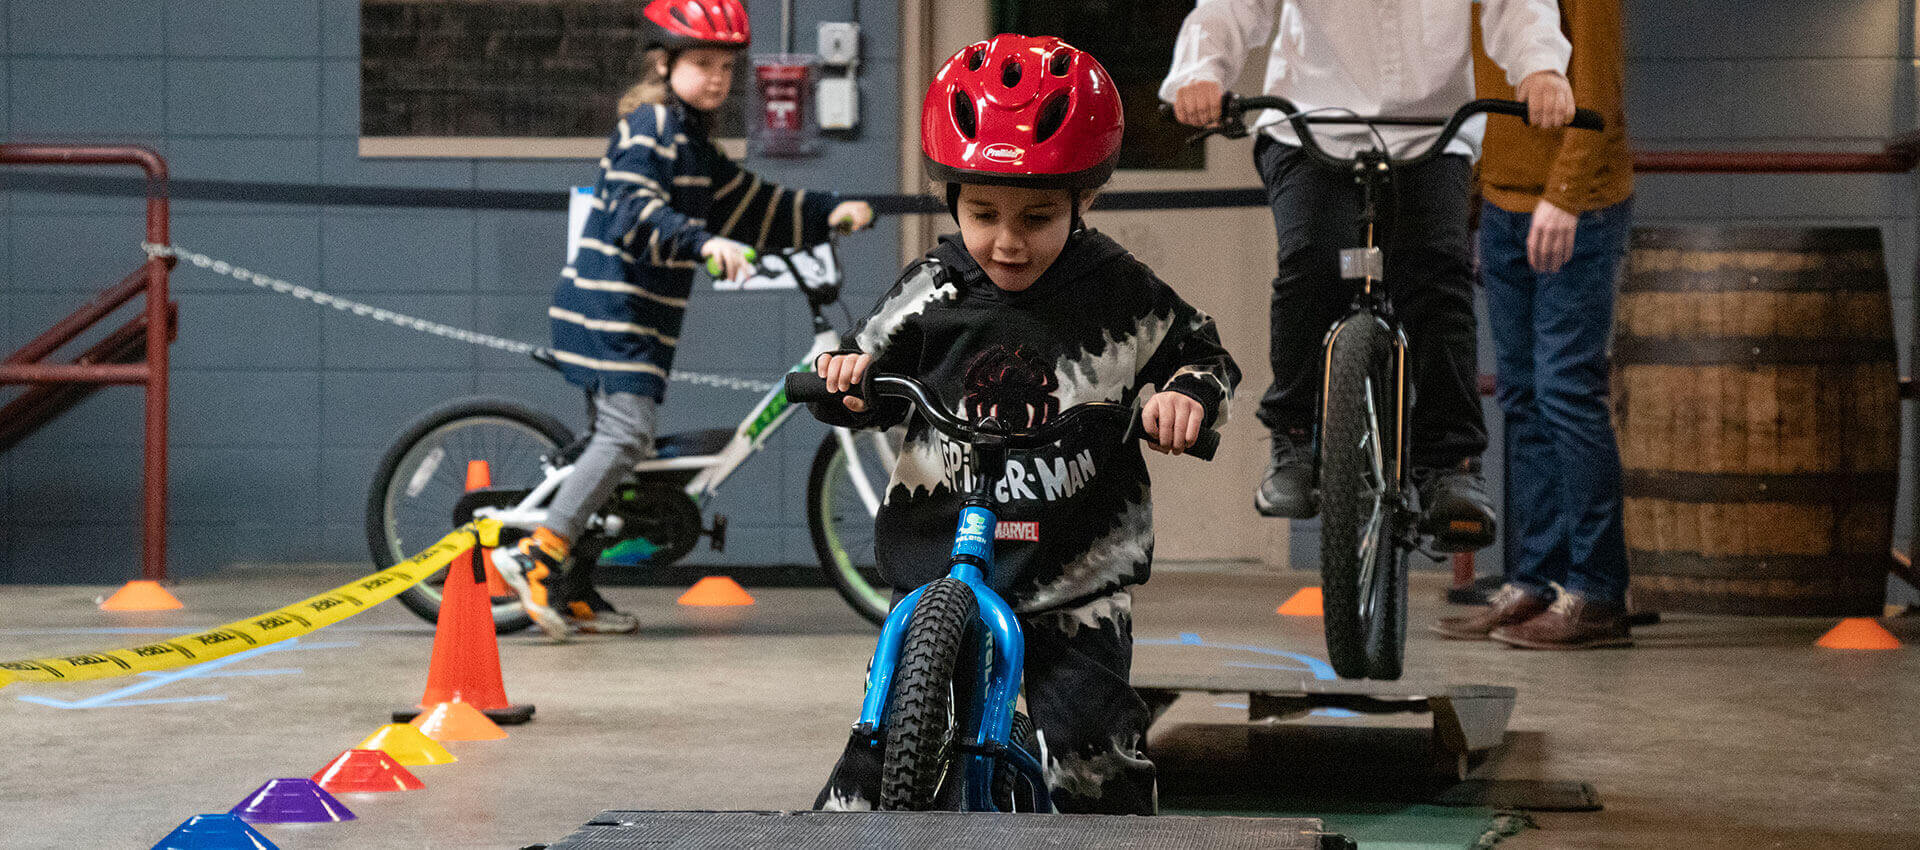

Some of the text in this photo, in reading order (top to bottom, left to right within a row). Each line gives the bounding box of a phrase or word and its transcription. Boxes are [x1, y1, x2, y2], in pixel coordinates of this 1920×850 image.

[995, 522, 1038, 540] MARVEL
[310, 597, 344, 613] TREK
[256, 615, 292, 631] TREK
[196, 631, 236, 646] TREK
[134, 644, 174, 657] TREK
[66, 653, 108, 667] TREK
